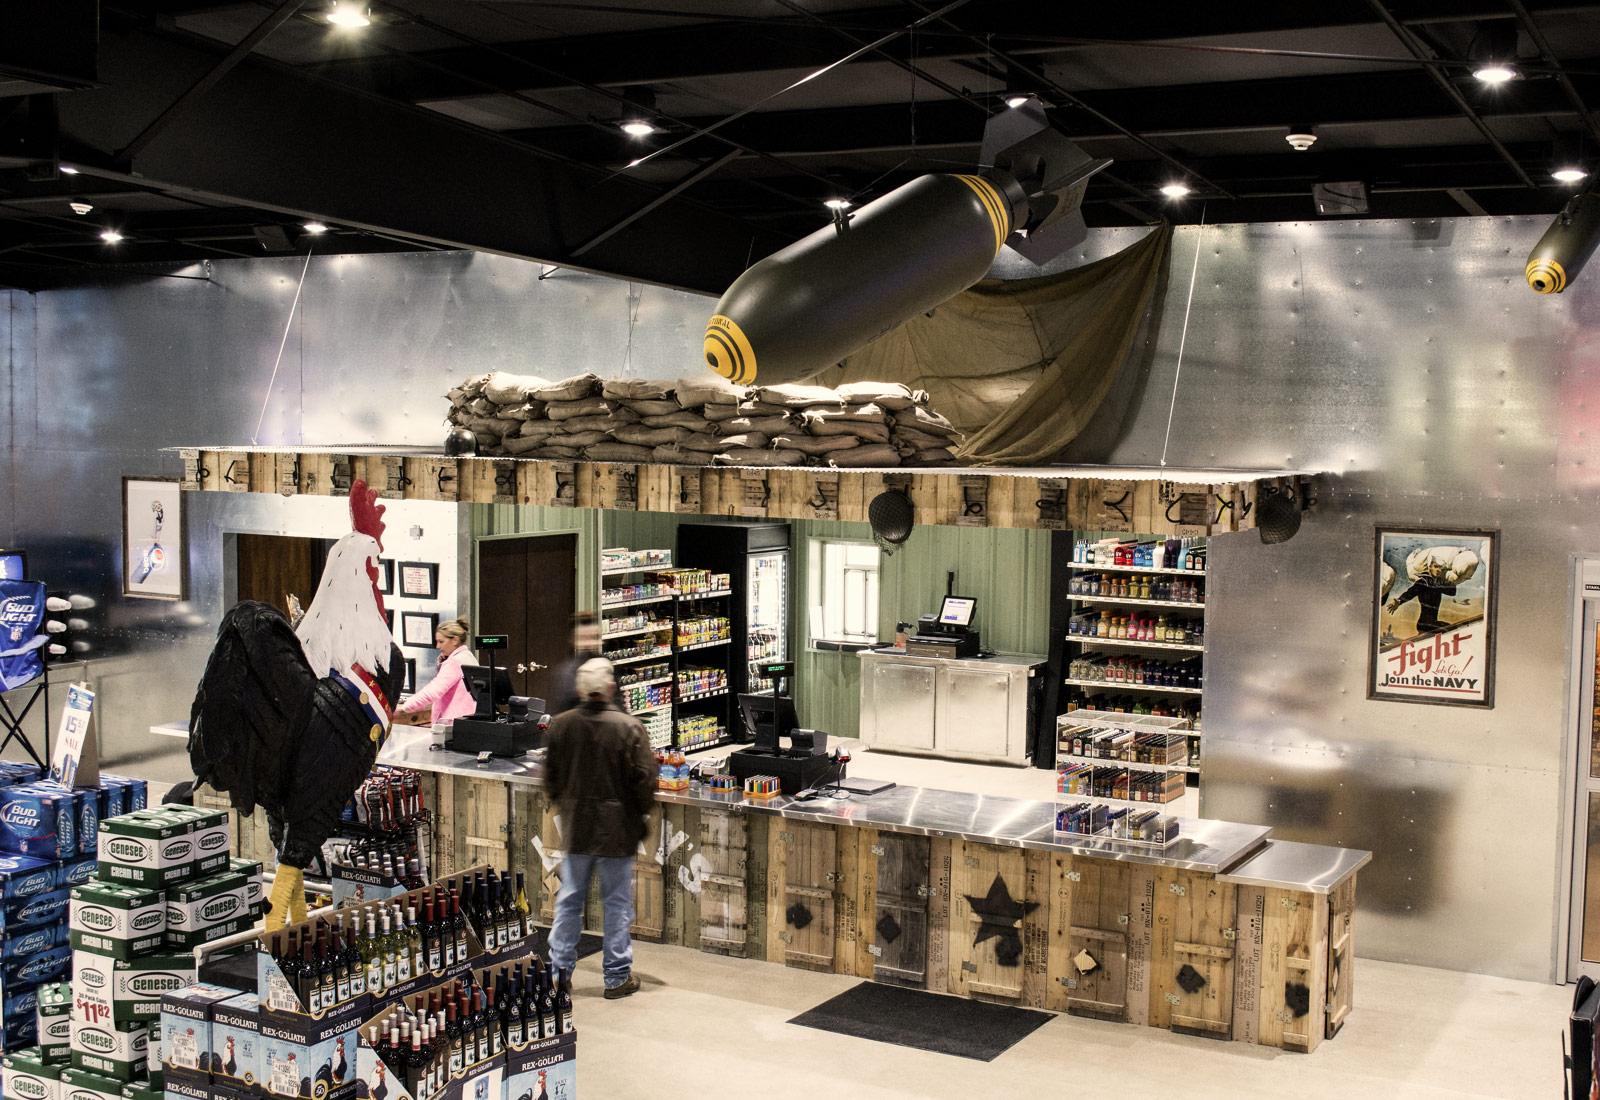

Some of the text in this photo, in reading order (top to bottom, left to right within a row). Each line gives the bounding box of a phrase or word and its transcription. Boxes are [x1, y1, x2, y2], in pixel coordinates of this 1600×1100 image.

[6, 602, 35, 613] BUD
[1388, 633, 1472, 676] fight
[1380, 674, 1478, 689] Join the NAVY
[12, 805, 37, 817] BUD
[6, 814, 40, 827] LIGHT
[200, 834, 225, 847] Genesee
[110, 842, 144, 858] Genesee
[165, 844, 190, 856] Genesee
[77, 864, 94, 874] BUD
[26, 877, 45, 886] BUD
[341, 870, 381, 884] REX-GOLIATH
[20, 884, 45, 894] LIGHT
[22, 899, 70, 917] BUD LIGHT
[204, 898, 237, 917] Genesee
[81, 911, 112, 927] Genesee
[134, 912, 162, 927] Genesee
[19, 941, 45, 952] LIGHT
[25, 935, 44, 945] BUD
[81, 971, 104, 985] Genesee
[133, 979, 179, 990] Genesee
[163, 1003, 204, 1019] REX-GOLIATH
[215, 1013, 258, 1030] REX-GOLIATH
[320, 1017, 362, 1040] REX-GOLIATH
[81, 1032, 113, 1048] Genesee
[262, 1027, 306, 1044] REX-GOLIATH
[522, 1053, 564, 1071] REX-GOLIATH
[14, 1079, 45, 1096] Genesee
[167, 1082, 208, 1099] REX-GOLIATH
